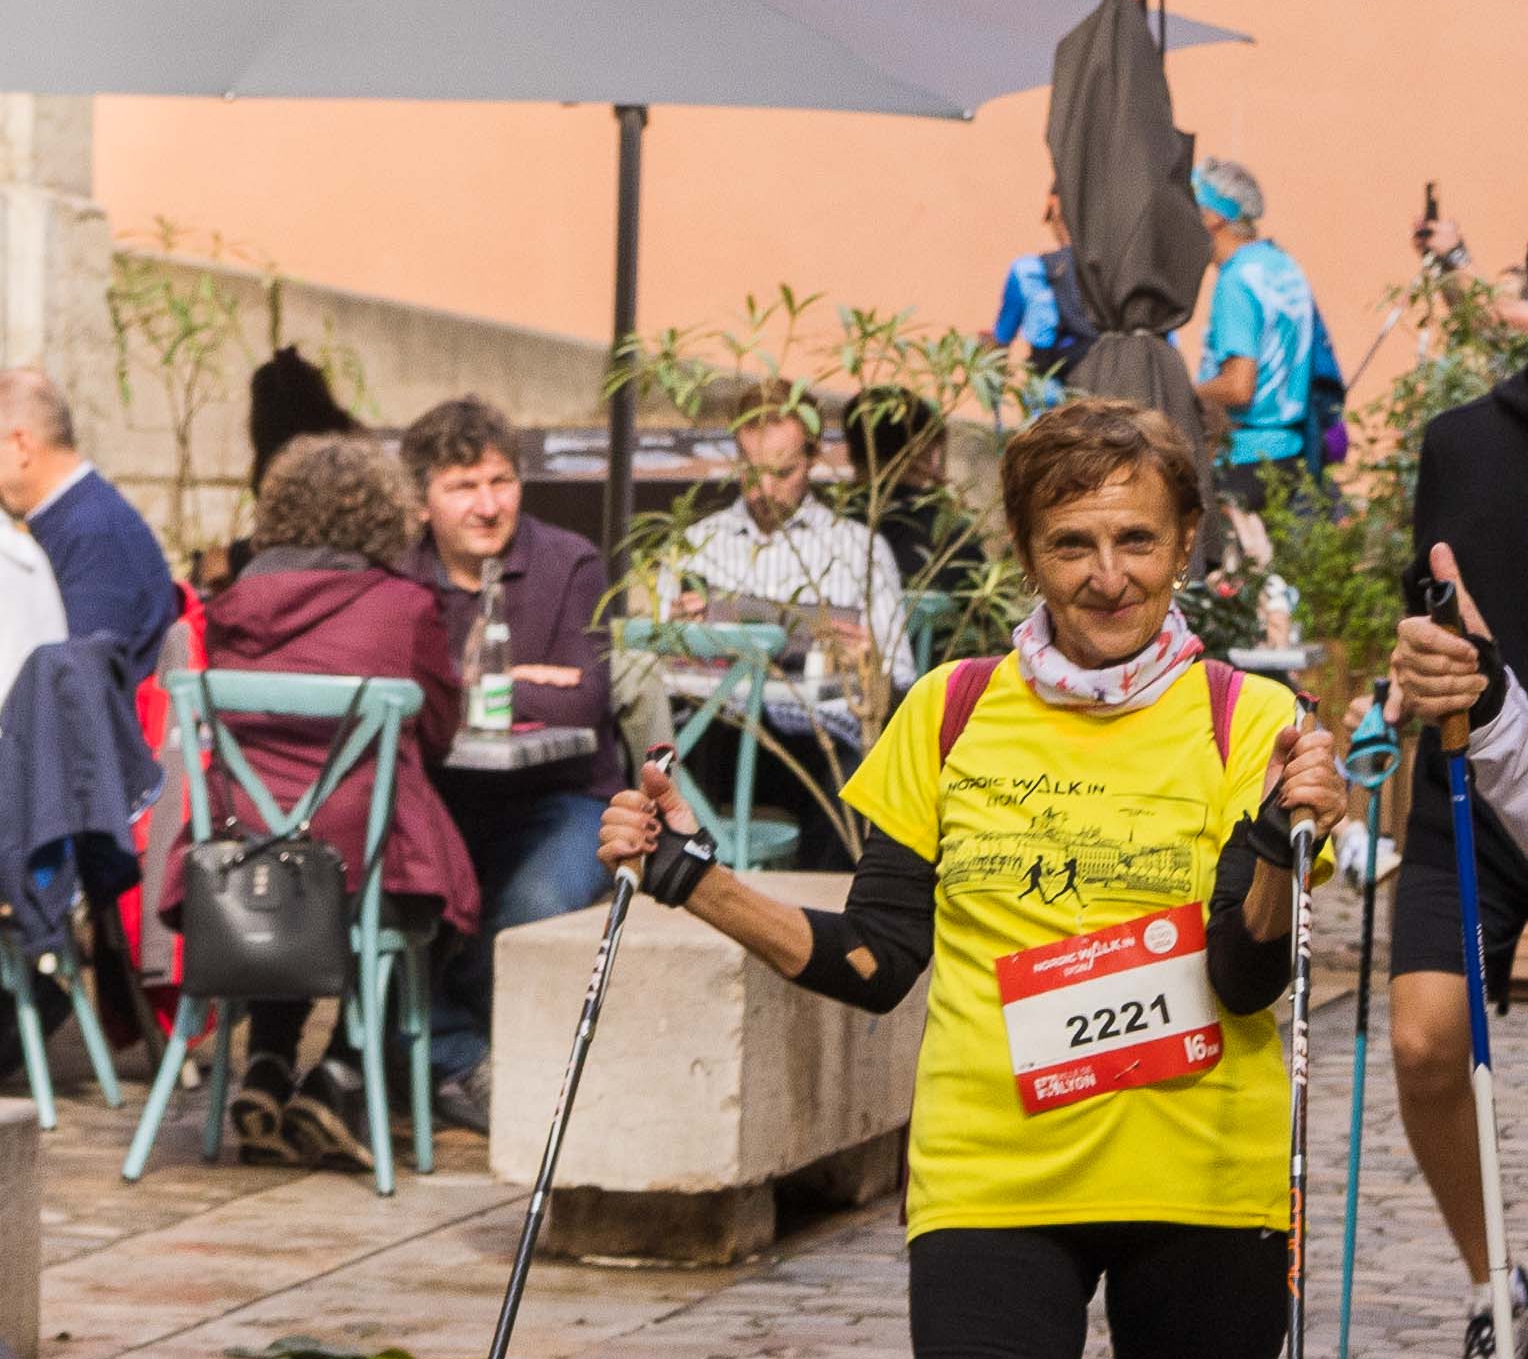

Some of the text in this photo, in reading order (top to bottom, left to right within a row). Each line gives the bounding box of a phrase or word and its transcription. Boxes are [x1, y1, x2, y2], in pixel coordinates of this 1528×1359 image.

[1012, 773, 1080, 805] WALK
[1087, 784, 1105, 795] IN
[1066, 993, 1170, 1048] 2221
[1183, 1033, 1208, 1064] 16
